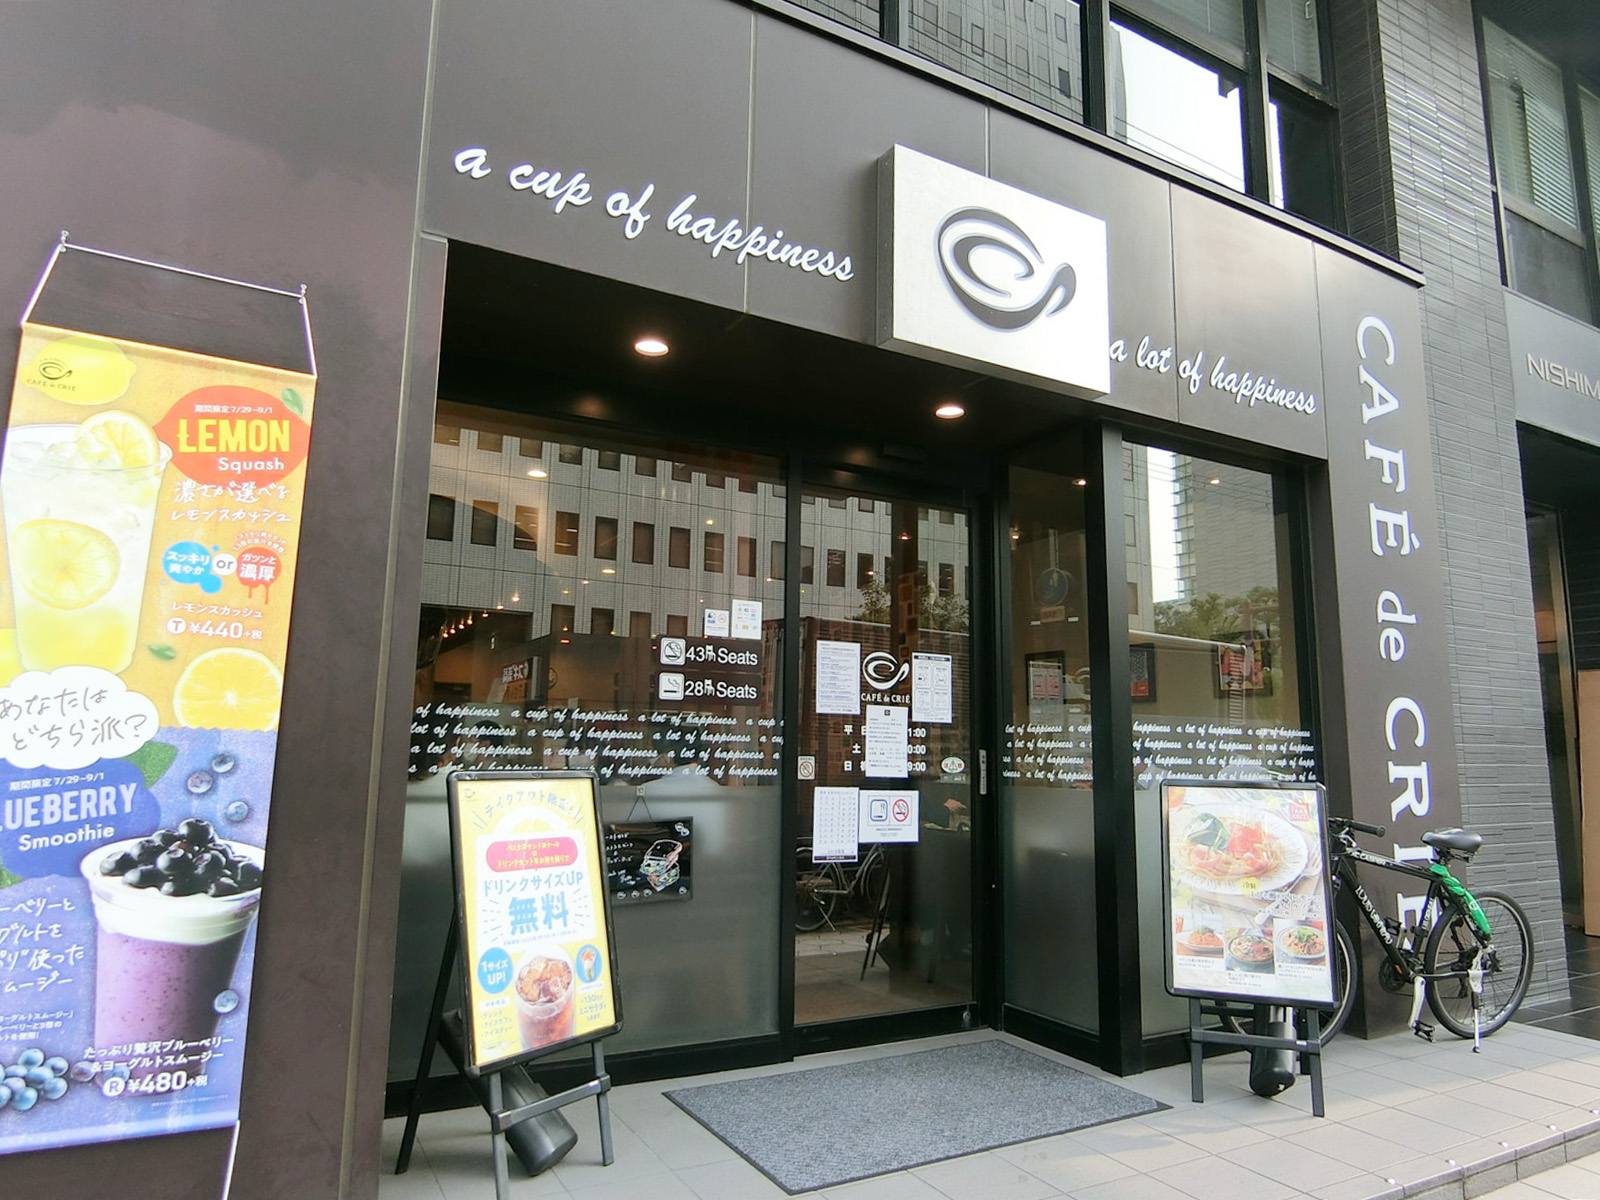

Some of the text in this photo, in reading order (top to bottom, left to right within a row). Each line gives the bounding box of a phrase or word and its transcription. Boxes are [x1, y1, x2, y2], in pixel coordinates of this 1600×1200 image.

[453, 147, 854, 281] a cup of happiness
[1109, 335, 1317, 414] a lot of happiness
[177, 418, 290, 453] LEMON
[1356, 315, 1421, 556] CAFÉ
[218, 456, 285, 474] Squash
[174, 478, 290, 503] 濃さが選べる
[171, 508, 292, 522] レモンスカッシュ
[166, 551, 210, 566] スッキリ
[216, 559, 234, 570] or
[242, 553, 277, 565] ガツンと
[240, 563, 276, 582] 濃厚
[172, 602, 264, 618] レモンスカッシュ
[1377, 589, 1417, 662] de
[686, 646, 758, 666] 43 Seats
[685, 680, 757, 699] 28 Seats
[0, 687, 108, 721] あなたは
[415, 703, 431, 718] of
[435, 702, 501, 718] happiness
[511, 709, 521, 718] a
[525, 709, 549, 721] cup
[553, 708, 567, 722] of
[571, 708, 628, 723] happiness
[638, 714, 647, 722] a
[651, 711, 667, 722] lot
[671, 712, 682, 726] of
[686, 712, 737, 726] happiness
[758, 717, 776, 728] cup
[433, 723, 449, 738] of
[453, 722, 517, 738] happiness
[527, 728, 537, 737] a
[542, 727, 564, 740] cup
[569, 727, 583, 741] of
[587, 726, 643, 741] happiness
[653, 732, 661, 740] a
[666, 729, 681, 740] lot
[685, 730, 697, 744] of
[700, 730, 751, 744] happiness
[1027, 722, 1062, 735] happiness
[1133, 721, 1171, 734] happiness
[1208, 724, 1242, 736] happiness
[410, 745, 421, 753] a
[426, 741, 446, 754] lot
[450, 742, 466, 757] of
[470, 741, 533, 758] happiness
[543, 747, 553, 755] a
[558, 746, 580, 758] cup
[585, 745, 599, 760] of
[602, 745, 658, 760] happiness
[667, 750, 676, 758] a
[680, 747, 695, 758] lot
[698, 748, 711, 761] of
[714, 747, 764, 761] happiness
[852, 743, 861, 754] 土
[1037, 738, 1073, 750] happiness
[1144, 738, 1181, 750] happiness
[1047, 753, 1084, 766] happiness
[1155, 754, 1192, 767] happiness
[600, 763, 614, 778] of
[617, 762, 673, 778] happiness
[713, 765, 726, 779] of
[728, 764, 778, 779] happiness
[0, 783, 137, 832] UEBERRY
[19, 824, 115, 851] Smoothie
[484, 870, 584, 896] ドリンクサイズUP
[509, 891, 569, 936] 無料
[487, 971, 507, 986] UP!
[83, 1036, 234, 1059] たっぷり贅沢ブルーベリー
[91, 1050, 225, 1073] &ヨーグルトスムージー
